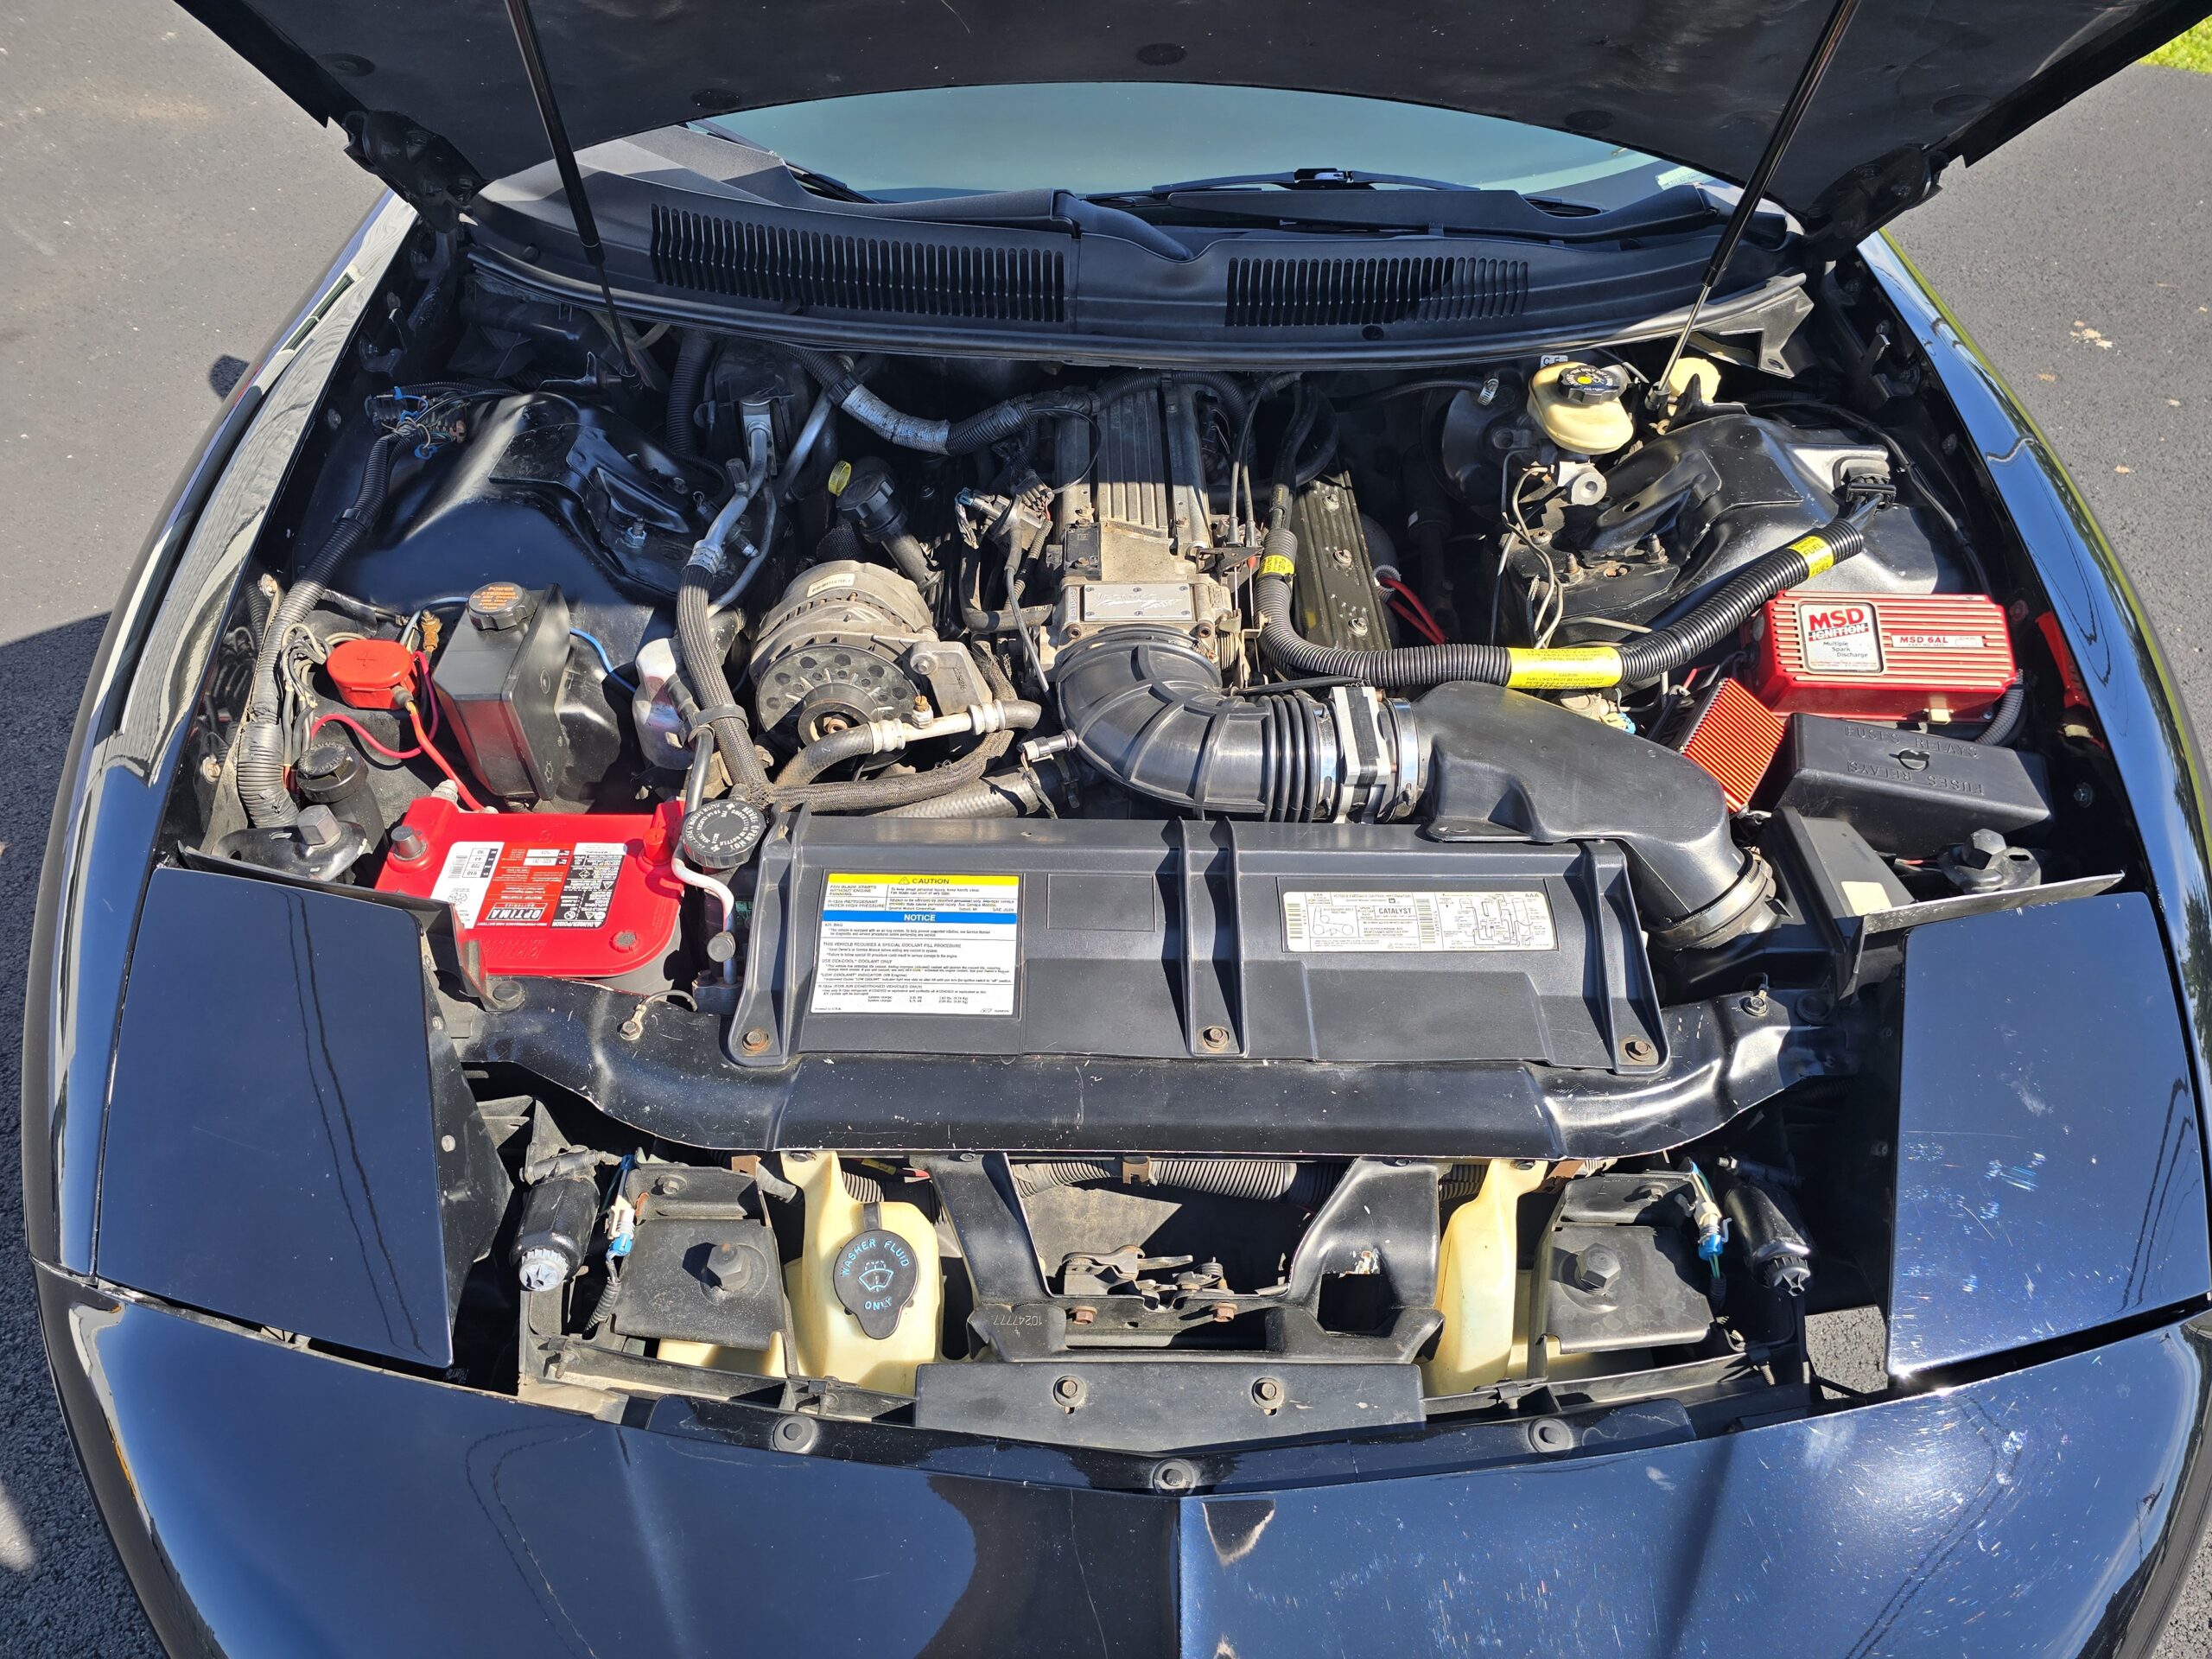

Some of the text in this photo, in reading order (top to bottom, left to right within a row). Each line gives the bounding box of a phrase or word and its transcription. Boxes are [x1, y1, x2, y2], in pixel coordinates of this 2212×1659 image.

[1803, 543, 1824, 556] FUEL
[1812, 562, 1829, 575] FUEL
[1808, 607, 1864, 631] MSD
[1811, 624, 1866, 639] IGNITION
[1844, 725, 1980, 760] FUSES RELAYS
[1847, 760, 1985, 797] FUSES RELAYS
[744, 825, 760, 842] OPEN
[729, 840, 747, 850] HOT
[490, 909, 542, 919] OPTIMA
[842, 1238, 910, 1277] WASHER FLUID
[864, 1297, 892, 1310] ONLY
[994, 1315, 1043, 1326] 10247777
